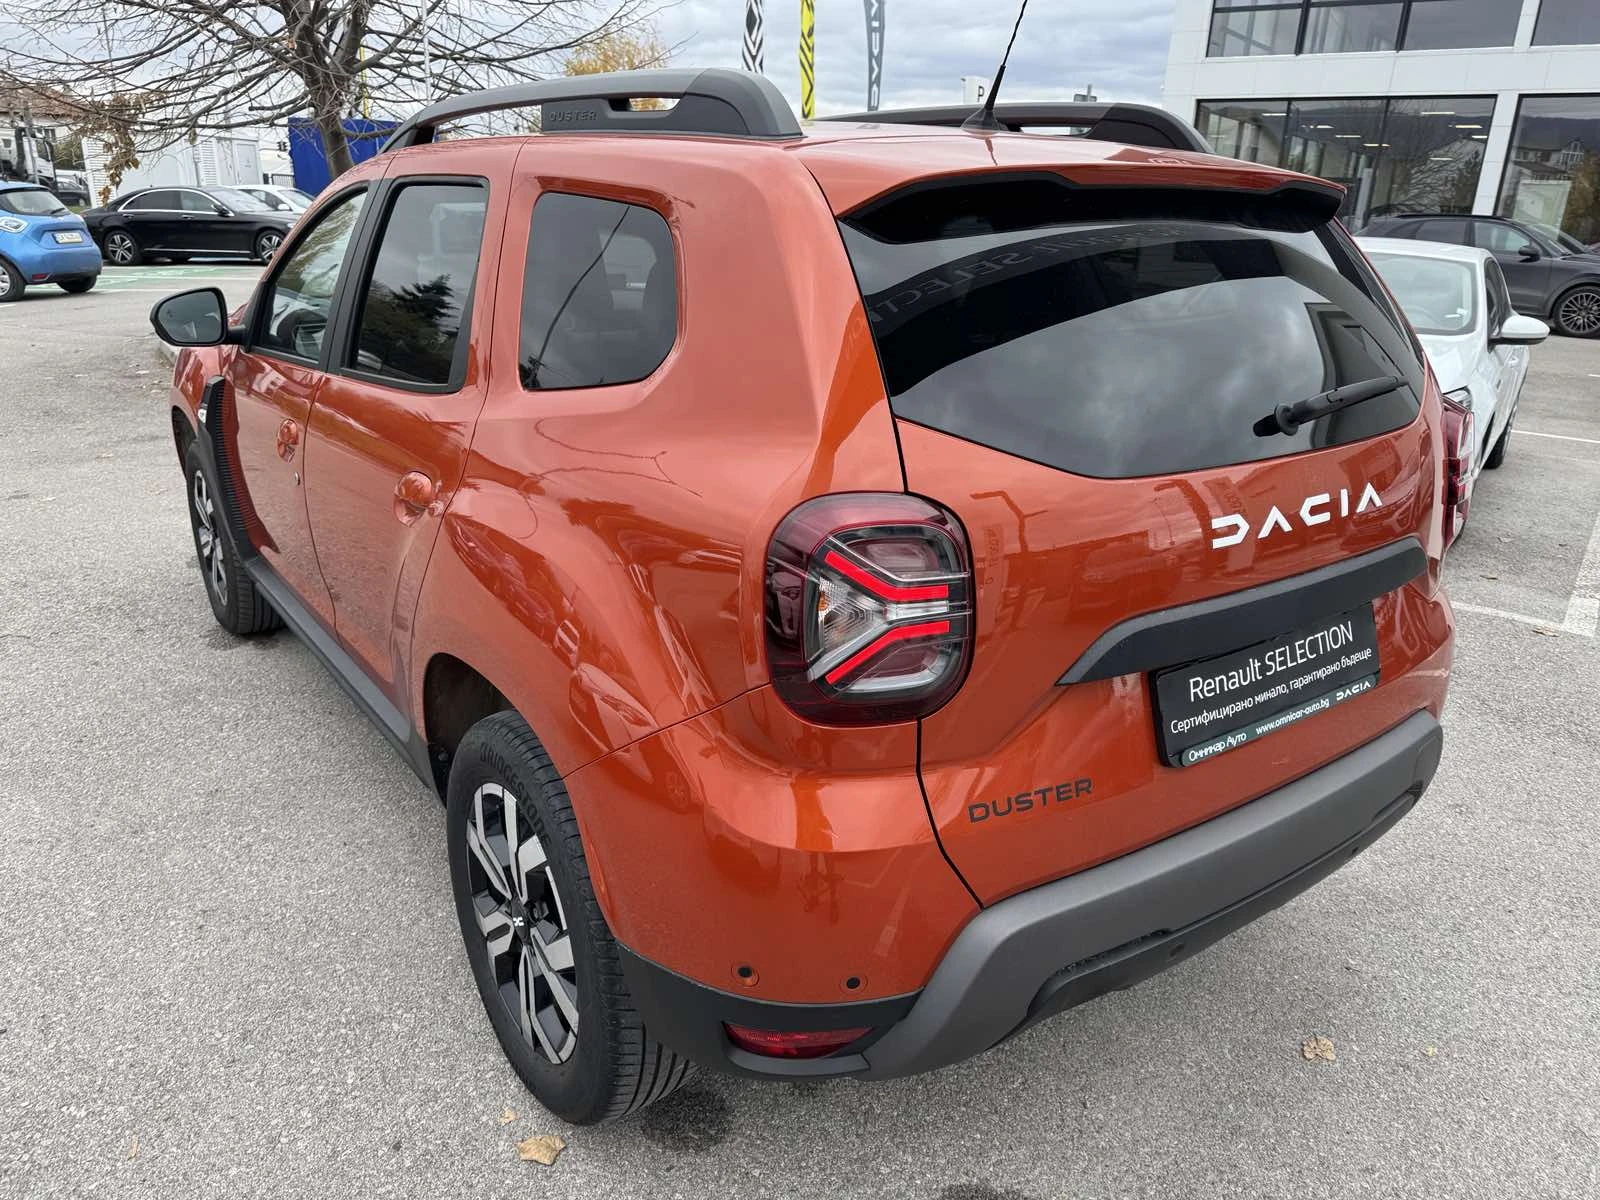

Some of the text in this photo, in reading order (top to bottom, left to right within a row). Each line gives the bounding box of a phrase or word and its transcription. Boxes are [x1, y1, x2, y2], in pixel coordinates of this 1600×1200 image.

[977, 85, 985, 103] P
[550, 110, 597, 122] DUSTER
[1211, 482, 1383, 549] DACIA
[1189, 620, 1353, 702] Renault SELECTION
[1170, 648, 1372, 734] Сертифицирано минало, гарантирано бъдеще
[1336, 681, 1371, 701] DACIA
[1256, 698, 1330, 735] www.omnicar-auto.bg
[1188, 732, 1247, 762] Омникар Ауто
[968, 777, 1093, 823] DUSTER
